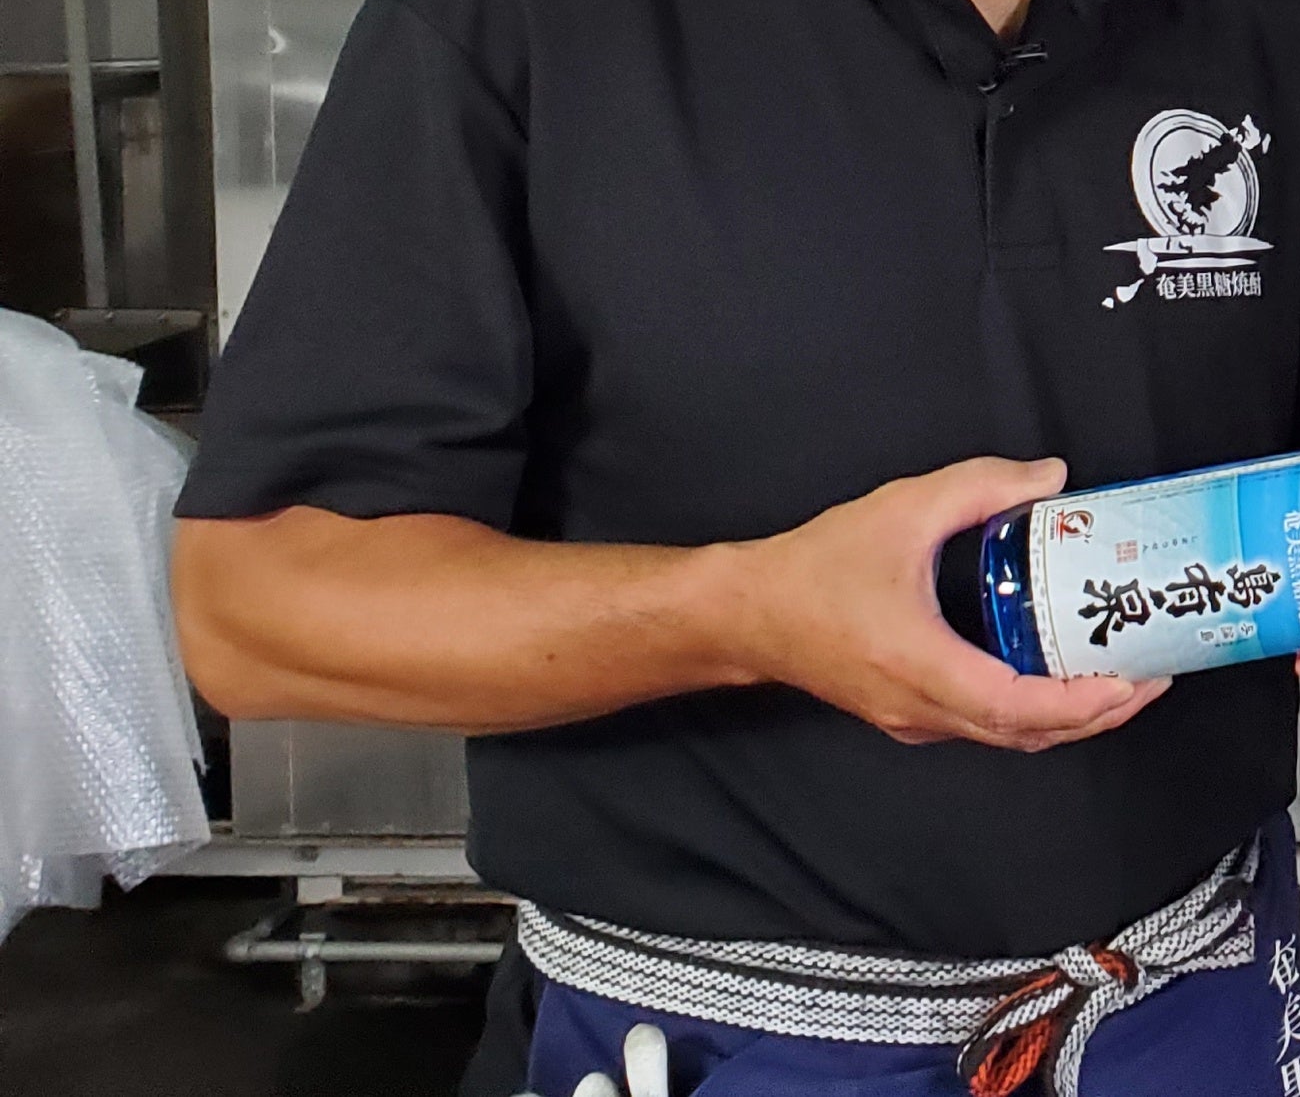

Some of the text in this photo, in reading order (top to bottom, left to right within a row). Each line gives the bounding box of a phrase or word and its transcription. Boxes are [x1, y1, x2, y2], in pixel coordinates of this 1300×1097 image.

[1156, 271, 1262, 300] 奄美黒糖焼酎
[1078, 562, 1282, 647] 島有泉
